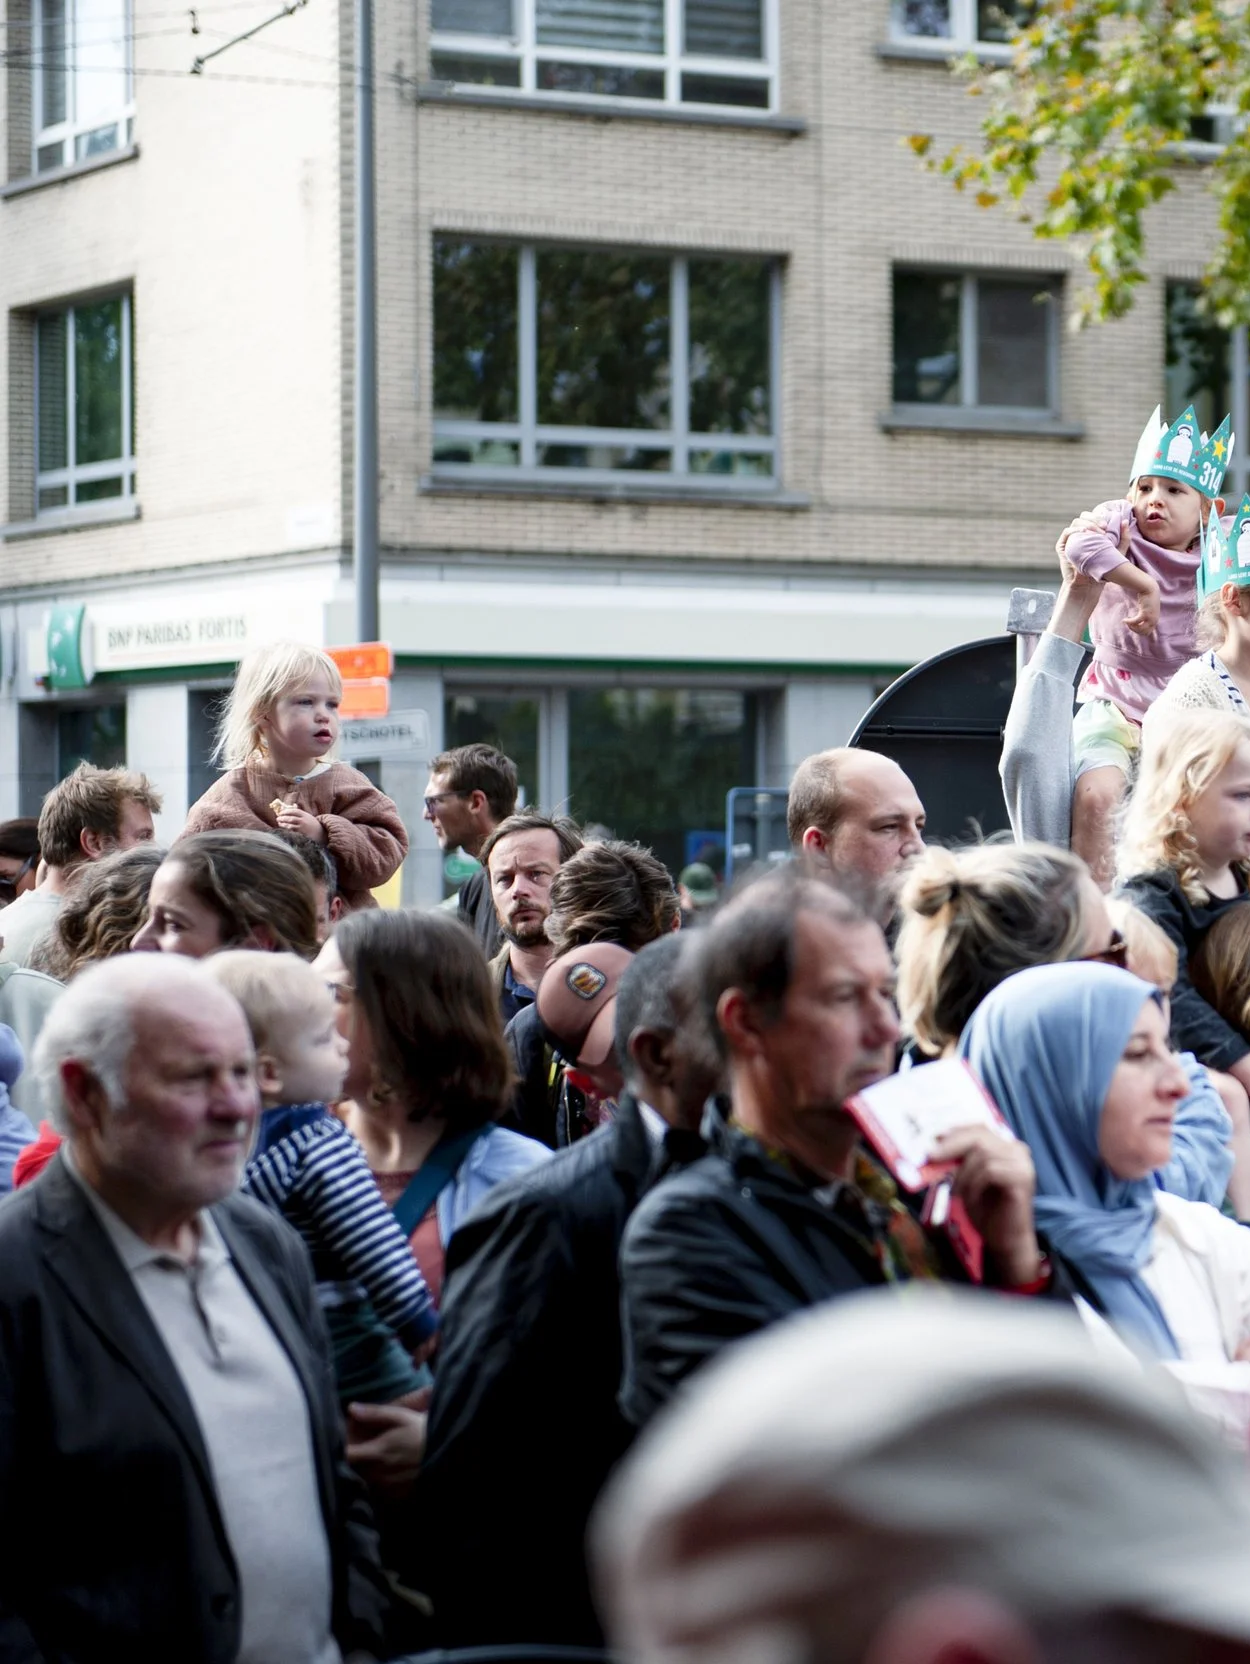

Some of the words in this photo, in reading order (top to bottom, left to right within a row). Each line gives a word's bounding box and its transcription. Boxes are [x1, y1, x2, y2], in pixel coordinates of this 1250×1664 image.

[1199, 461, 1223, 495] 314
[108, 627, 133, 648] BNP
[136, 621, 192, 645] PARIBAS
[199, 616, 247, 638] FORTIS
